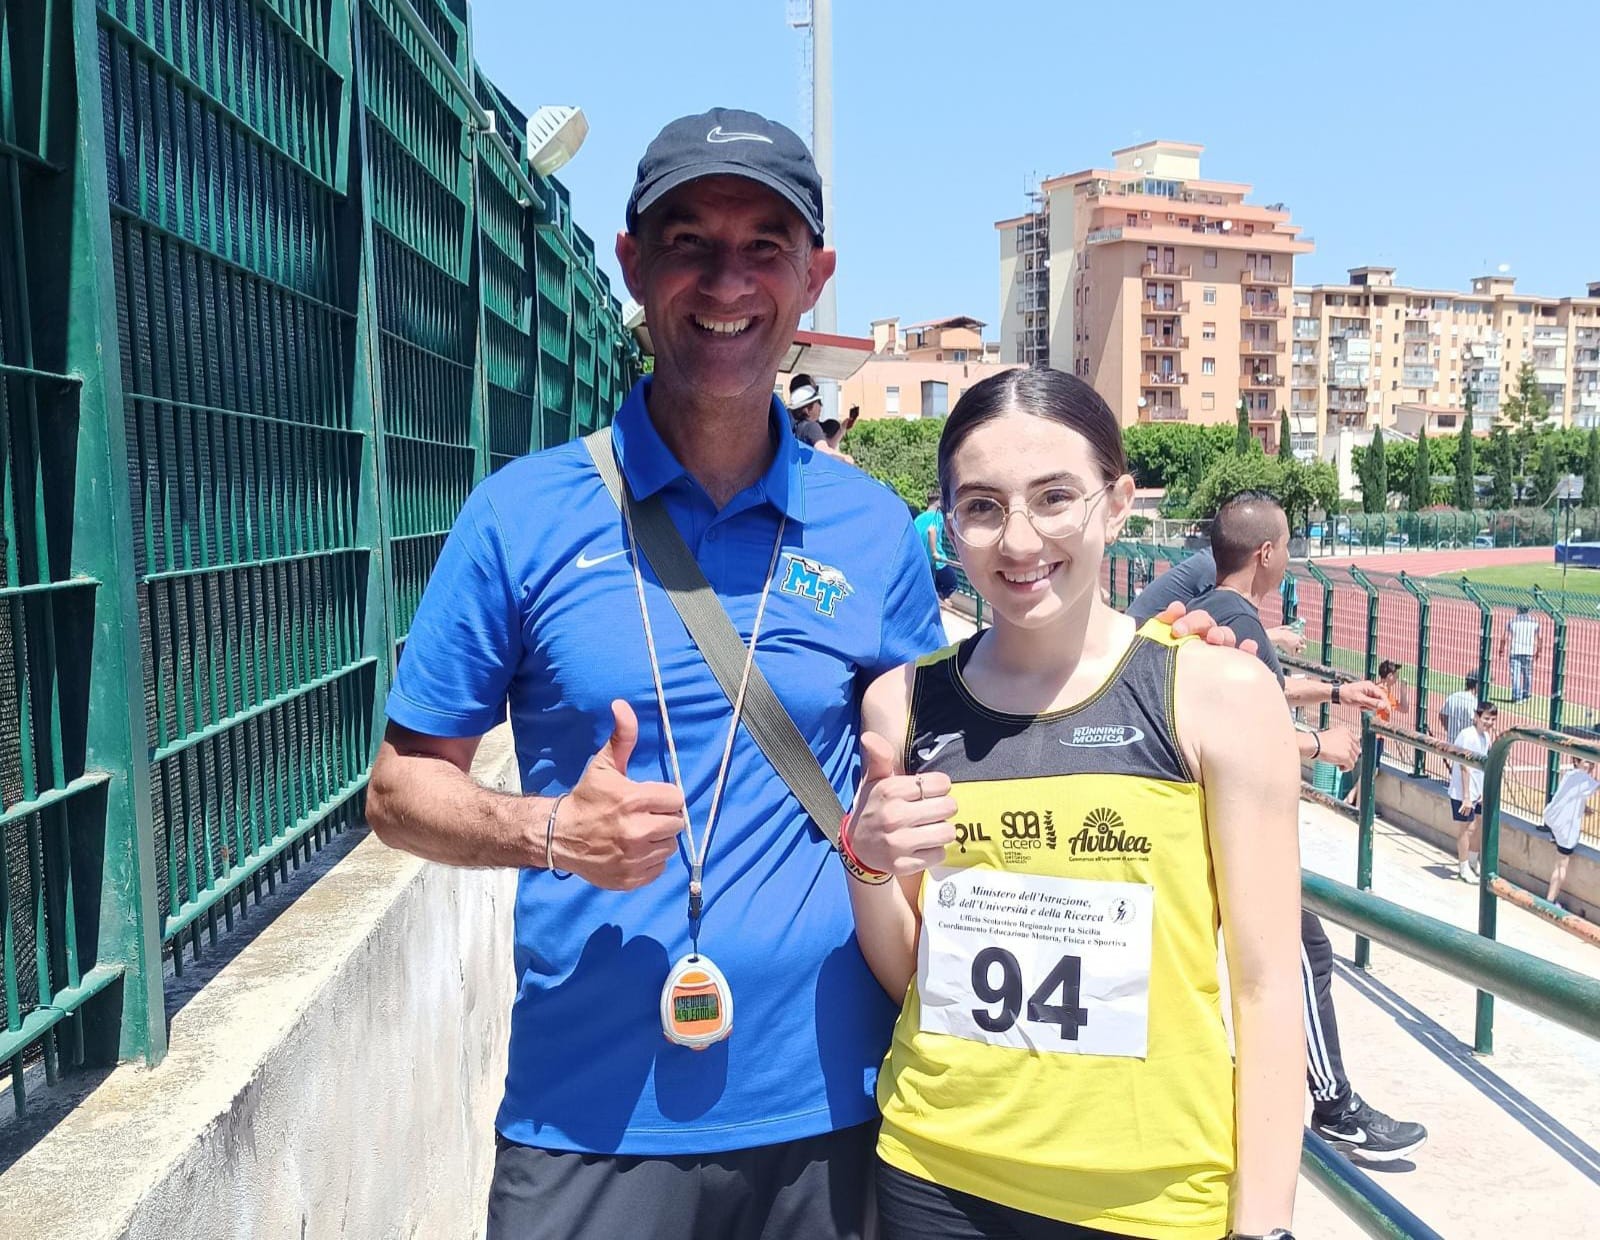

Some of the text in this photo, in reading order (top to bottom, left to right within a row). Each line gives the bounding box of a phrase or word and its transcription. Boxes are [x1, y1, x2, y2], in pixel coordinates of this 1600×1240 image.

[780, 557, 844, 616] MT
[1072, 734, 1124, 745] MODICA
[1073, 726, 1125, 737] RUNNING
[1068, 828, 1152, 856] Aviblea
[971, 886, 1016, 899] Ministero
[959, 899, 1104, 922] dell'Università e della Ricerca
[1068, 926, 1075, 934] la
[971, 946, 1088, 1041] 94
